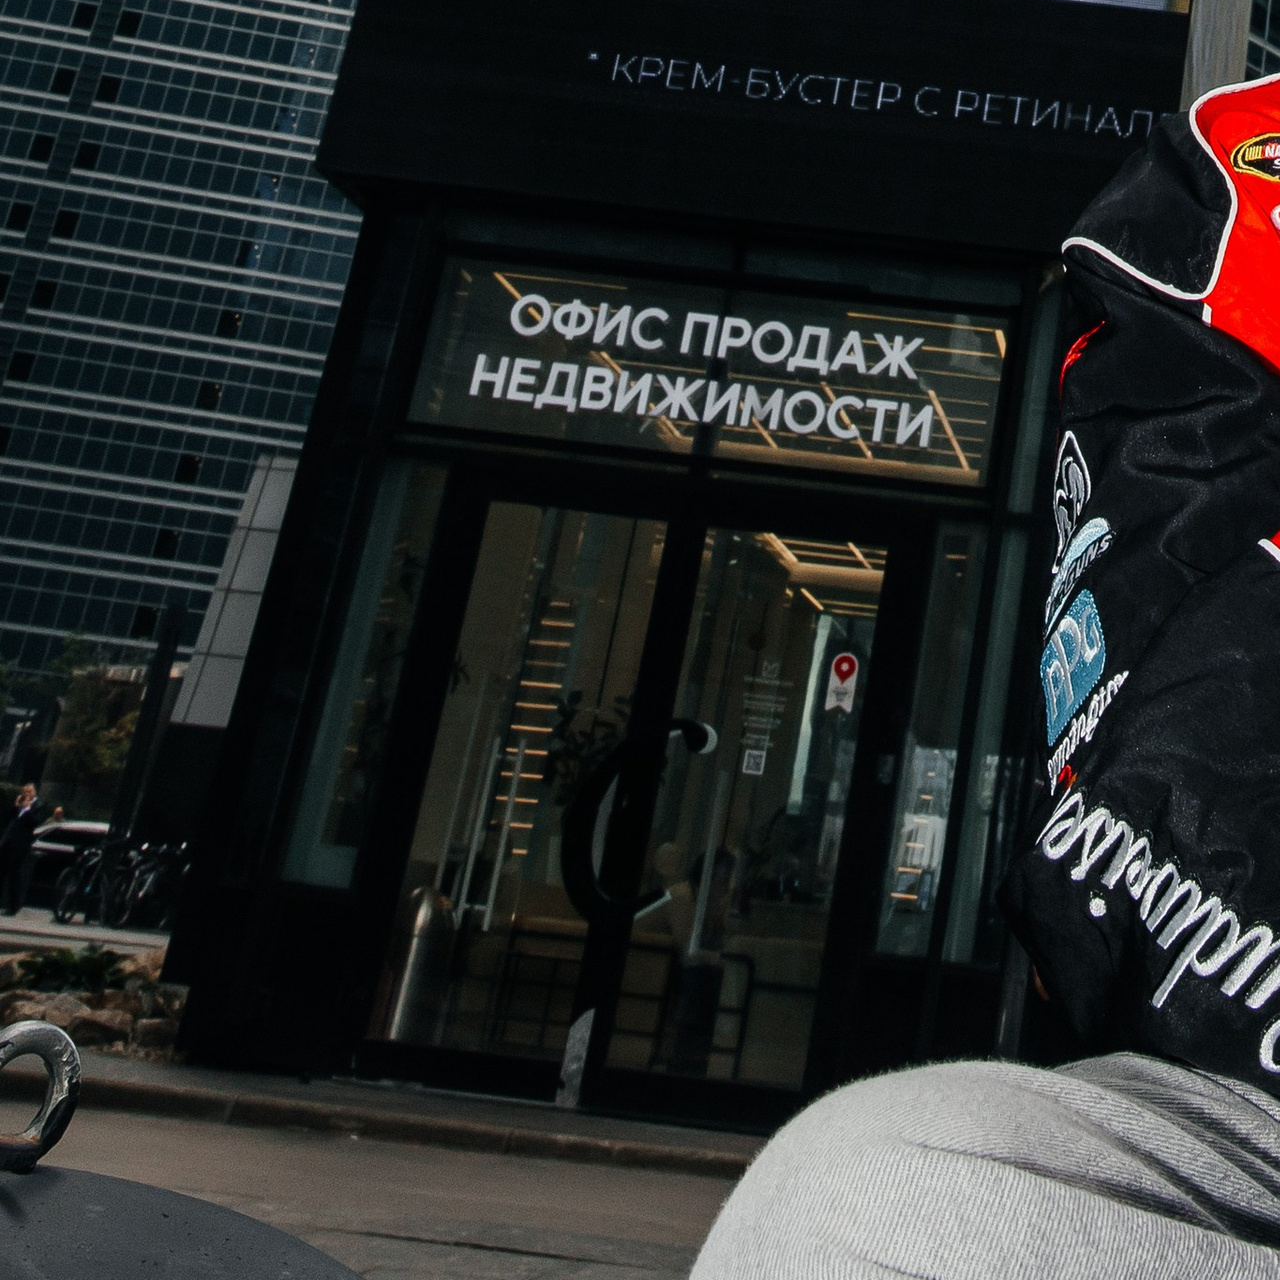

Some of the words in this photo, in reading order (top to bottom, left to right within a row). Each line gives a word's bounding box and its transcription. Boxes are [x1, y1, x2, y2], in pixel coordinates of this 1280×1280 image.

[612, 53, 902, 111] КРЕМ-БУСТЕР
[914, 86, 939, 117] С
[954, 90, 1172, 139] РЕТИНАЛ
[510, 292, 668, 351] ОФИС
[679, 310, 926, 381] ПРОДАЖ
[469, 353, 934, 448] НЕДВИЖИМОСТИ
